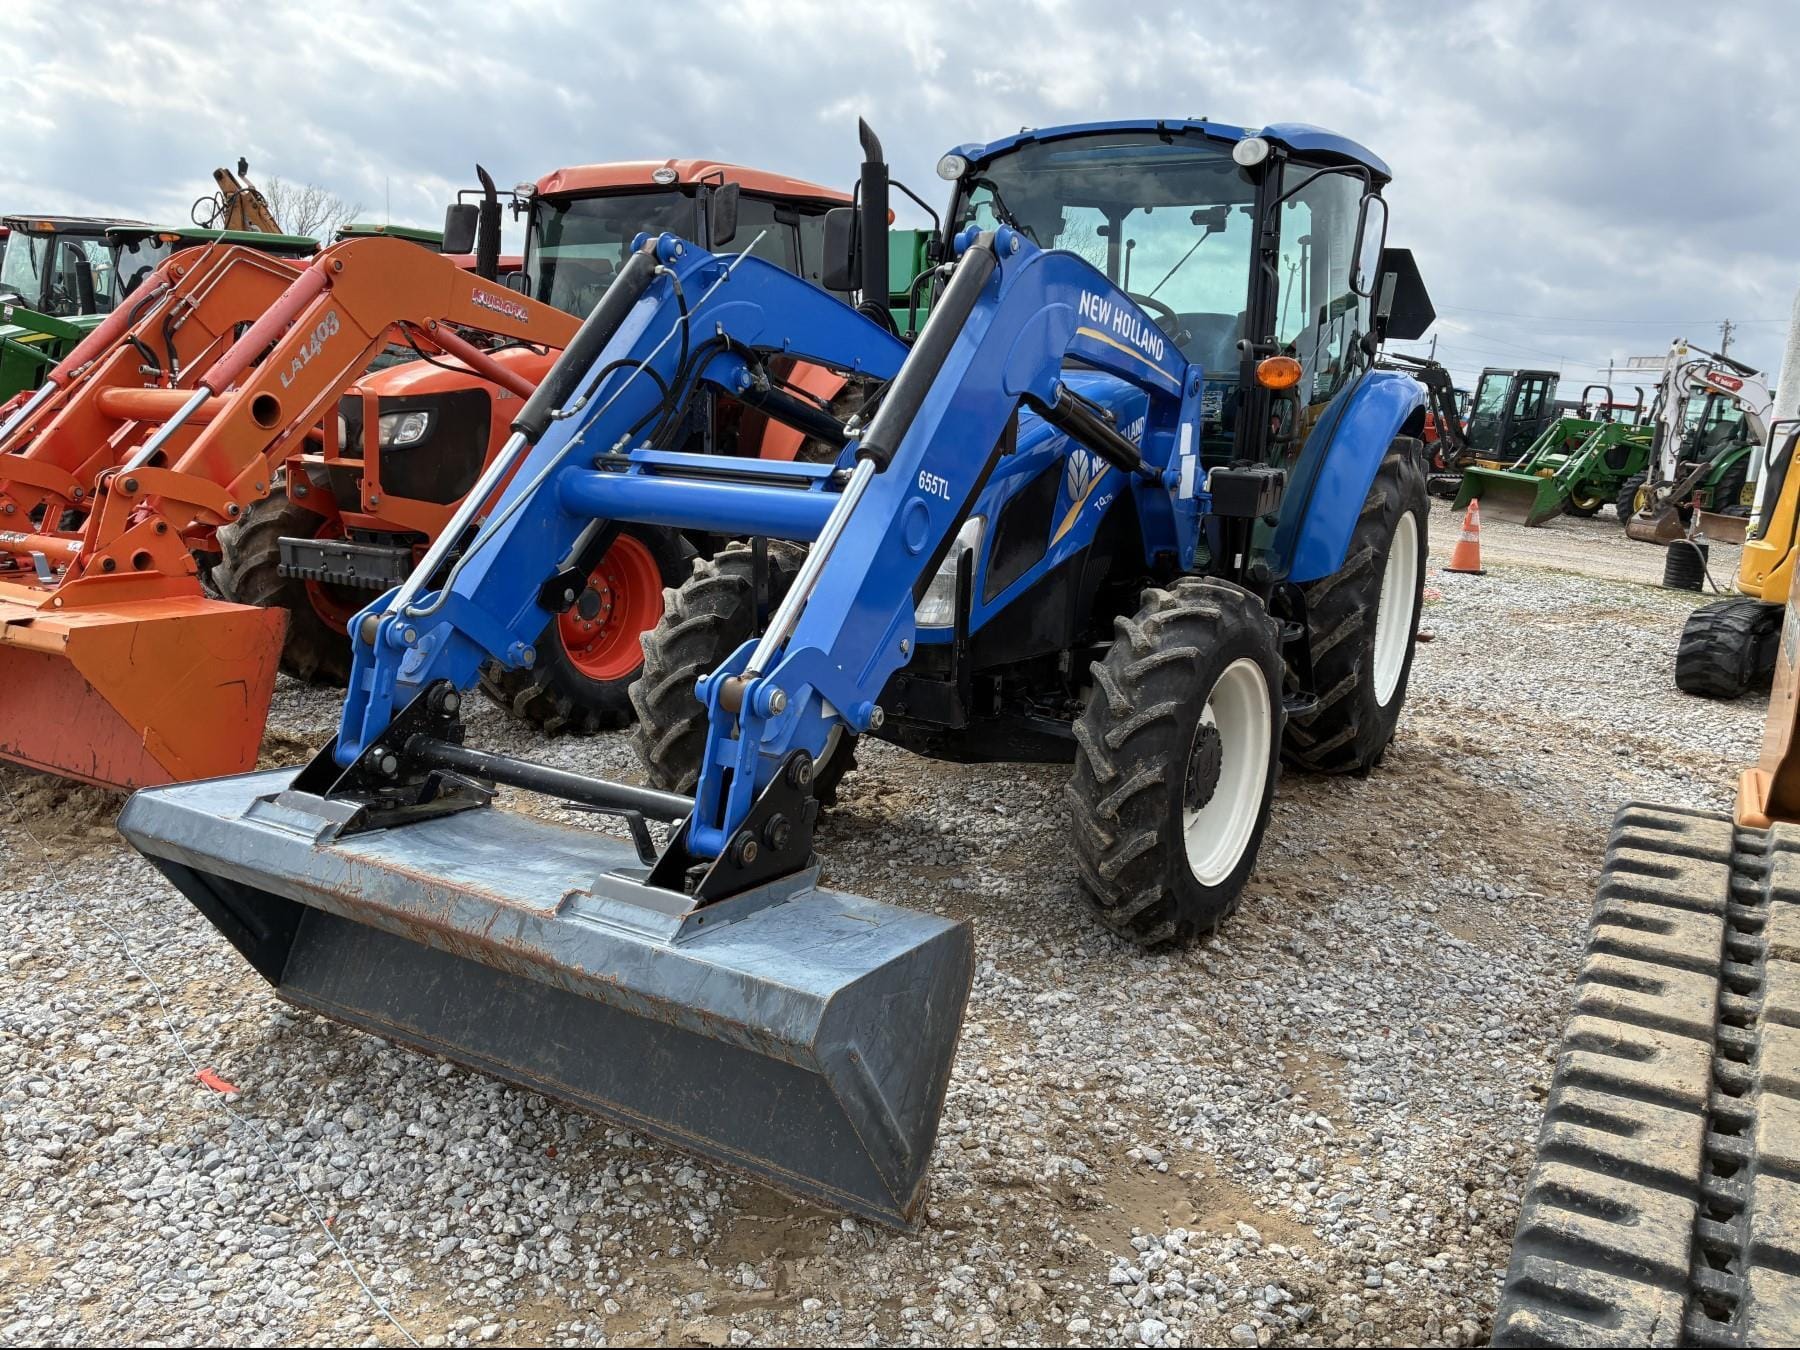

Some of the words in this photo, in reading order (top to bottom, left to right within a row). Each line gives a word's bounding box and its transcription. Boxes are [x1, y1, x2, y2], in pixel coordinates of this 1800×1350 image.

[472, 287, 528, 323] KUBOTA
[1078, 289, 1112, 326] NEW
[1112, 306, 1165, 362] HOLLAND
[280, 310, 340, 389] LA1403
[1092, 455, 1107, 478] NE
[918, 470, 951, 501] 655TL
